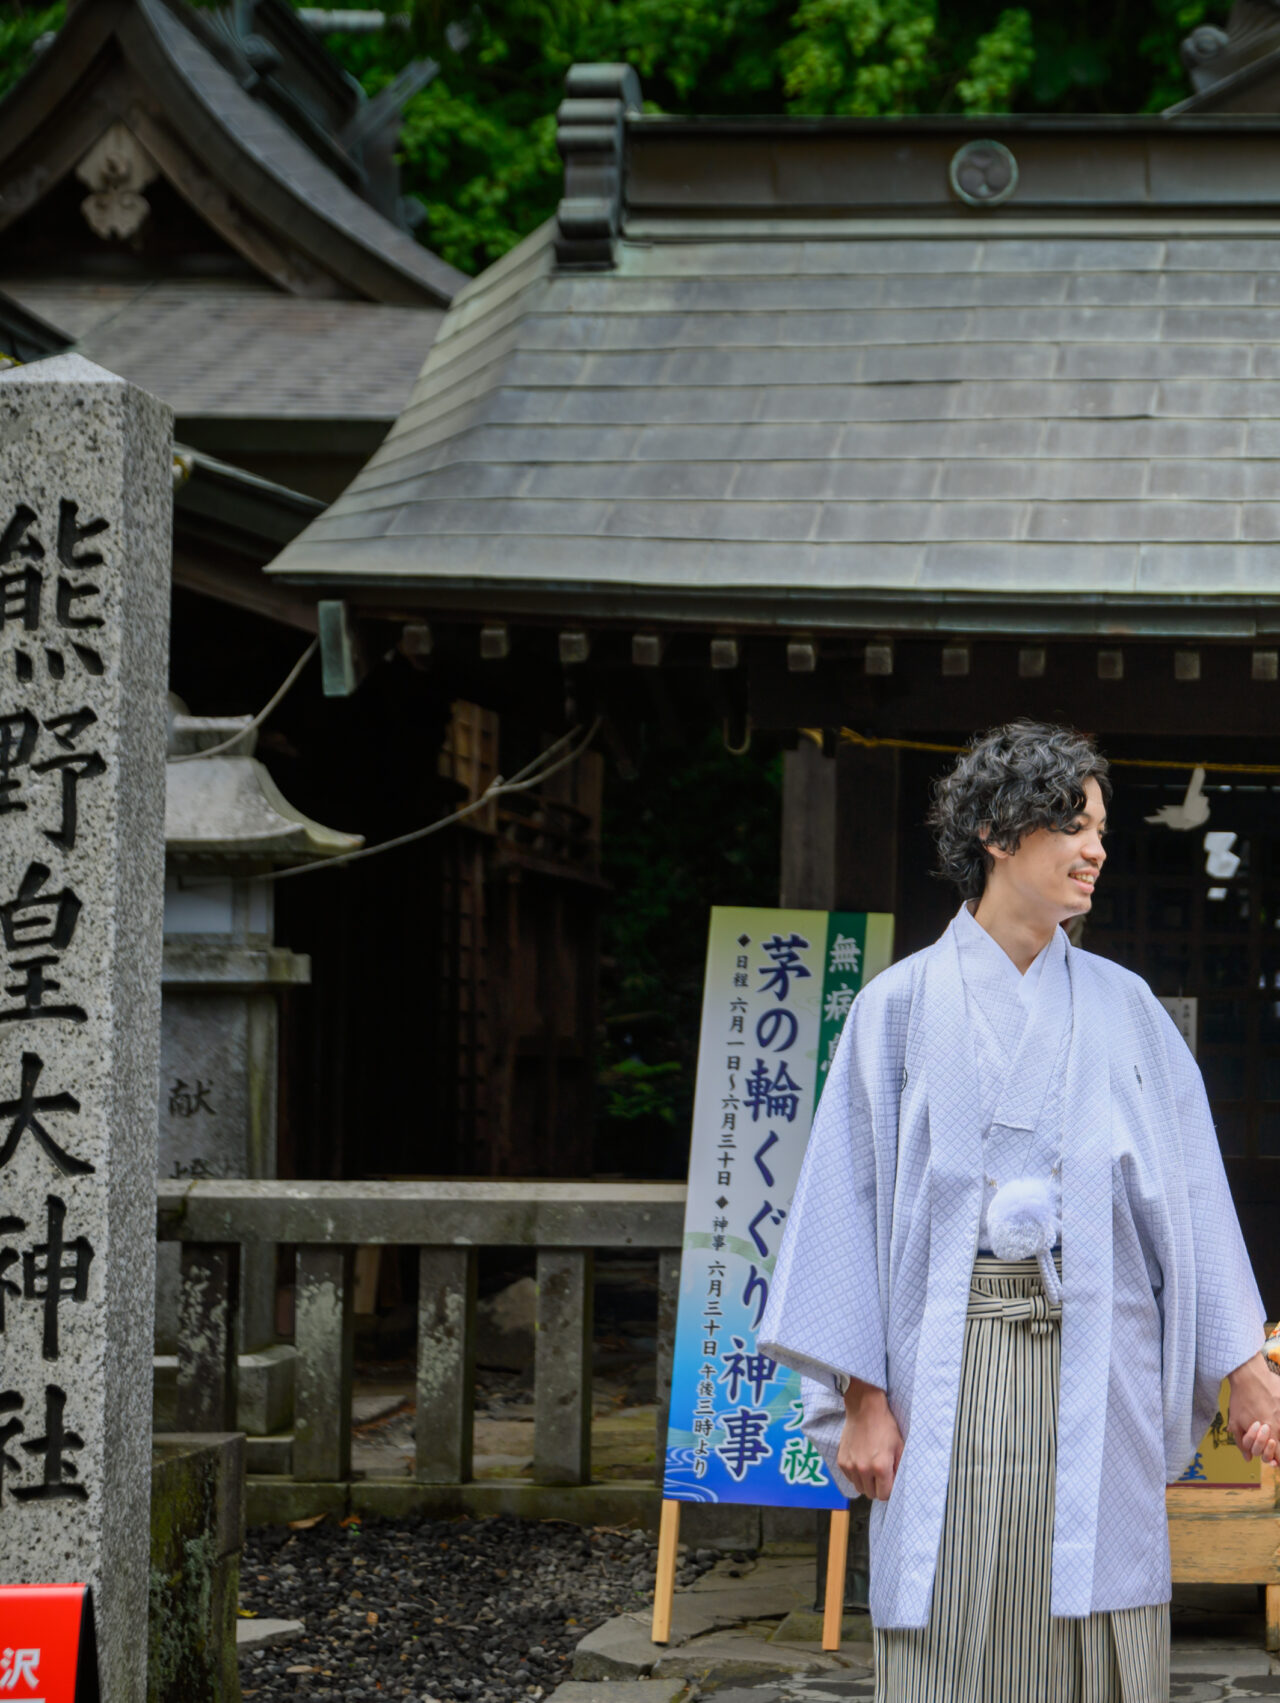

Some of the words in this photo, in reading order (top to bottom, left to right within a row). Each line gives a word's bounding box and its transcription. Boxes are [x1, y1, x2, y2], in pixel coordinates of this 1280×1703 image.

[715, 933, 812, 1480] 茅の輪くぐり神事
[0, 1647, 41, 1690] 沢
